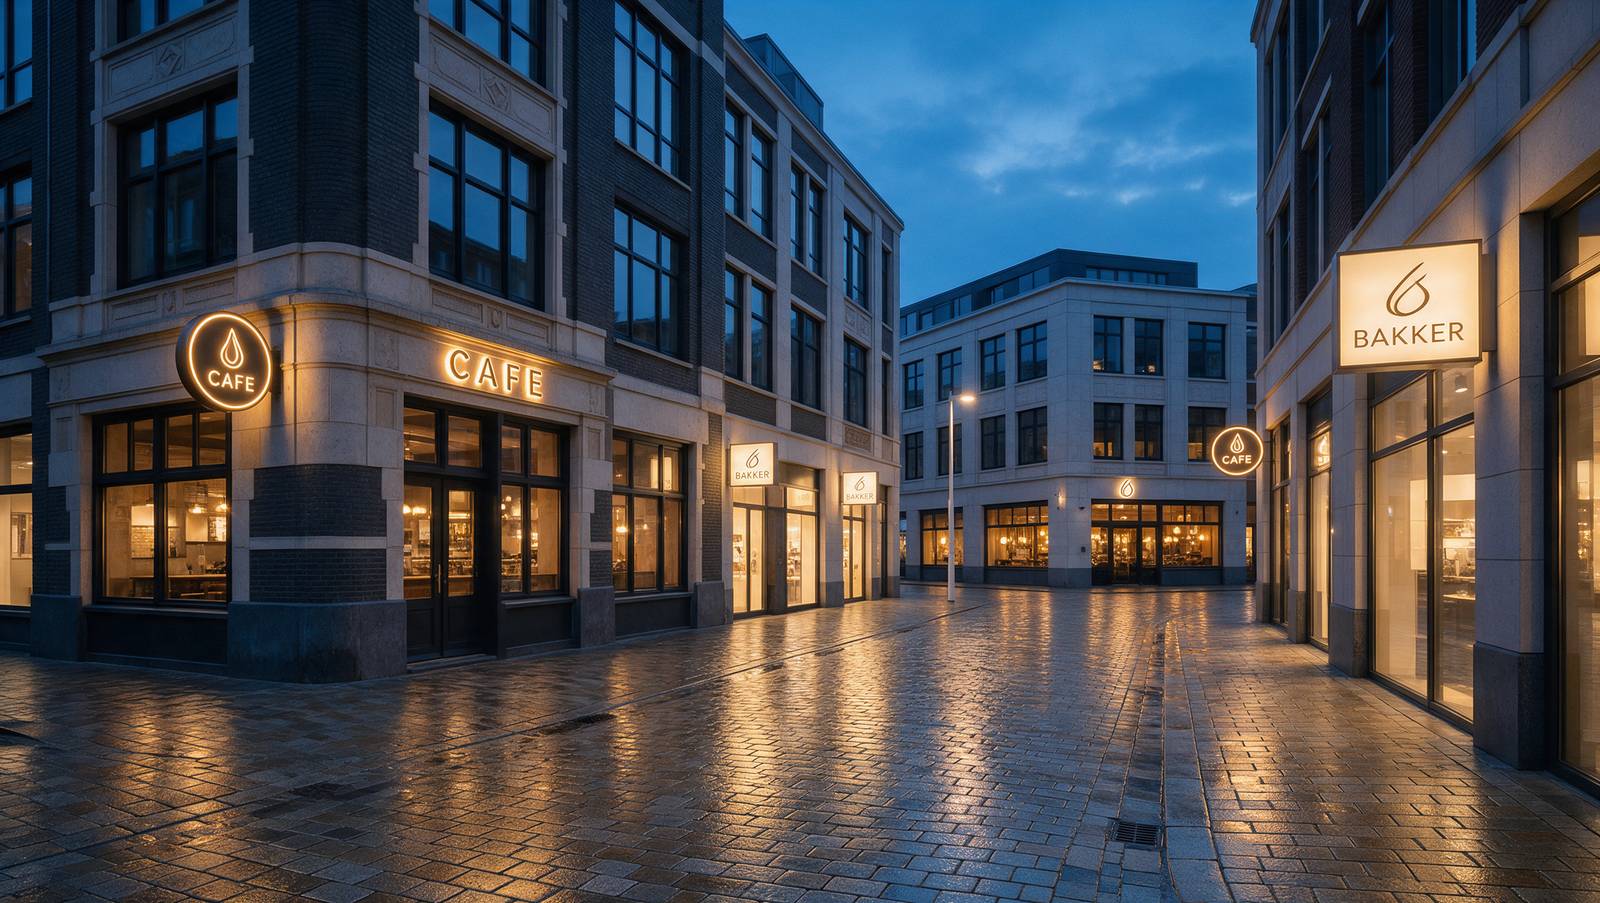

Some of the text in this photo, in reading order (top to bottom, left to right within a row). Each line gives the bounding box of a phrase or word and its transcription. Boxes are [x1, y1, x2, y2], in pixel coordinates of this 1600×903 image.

[1353, 321, 1465, 348] BAKKER
[207, 369, 254, 393] CAFE
[447, 349, 544, 398] CAFE
[1221, 455, 1252, 465] CAFE
[735, 471, 769, 480] BAKKER
